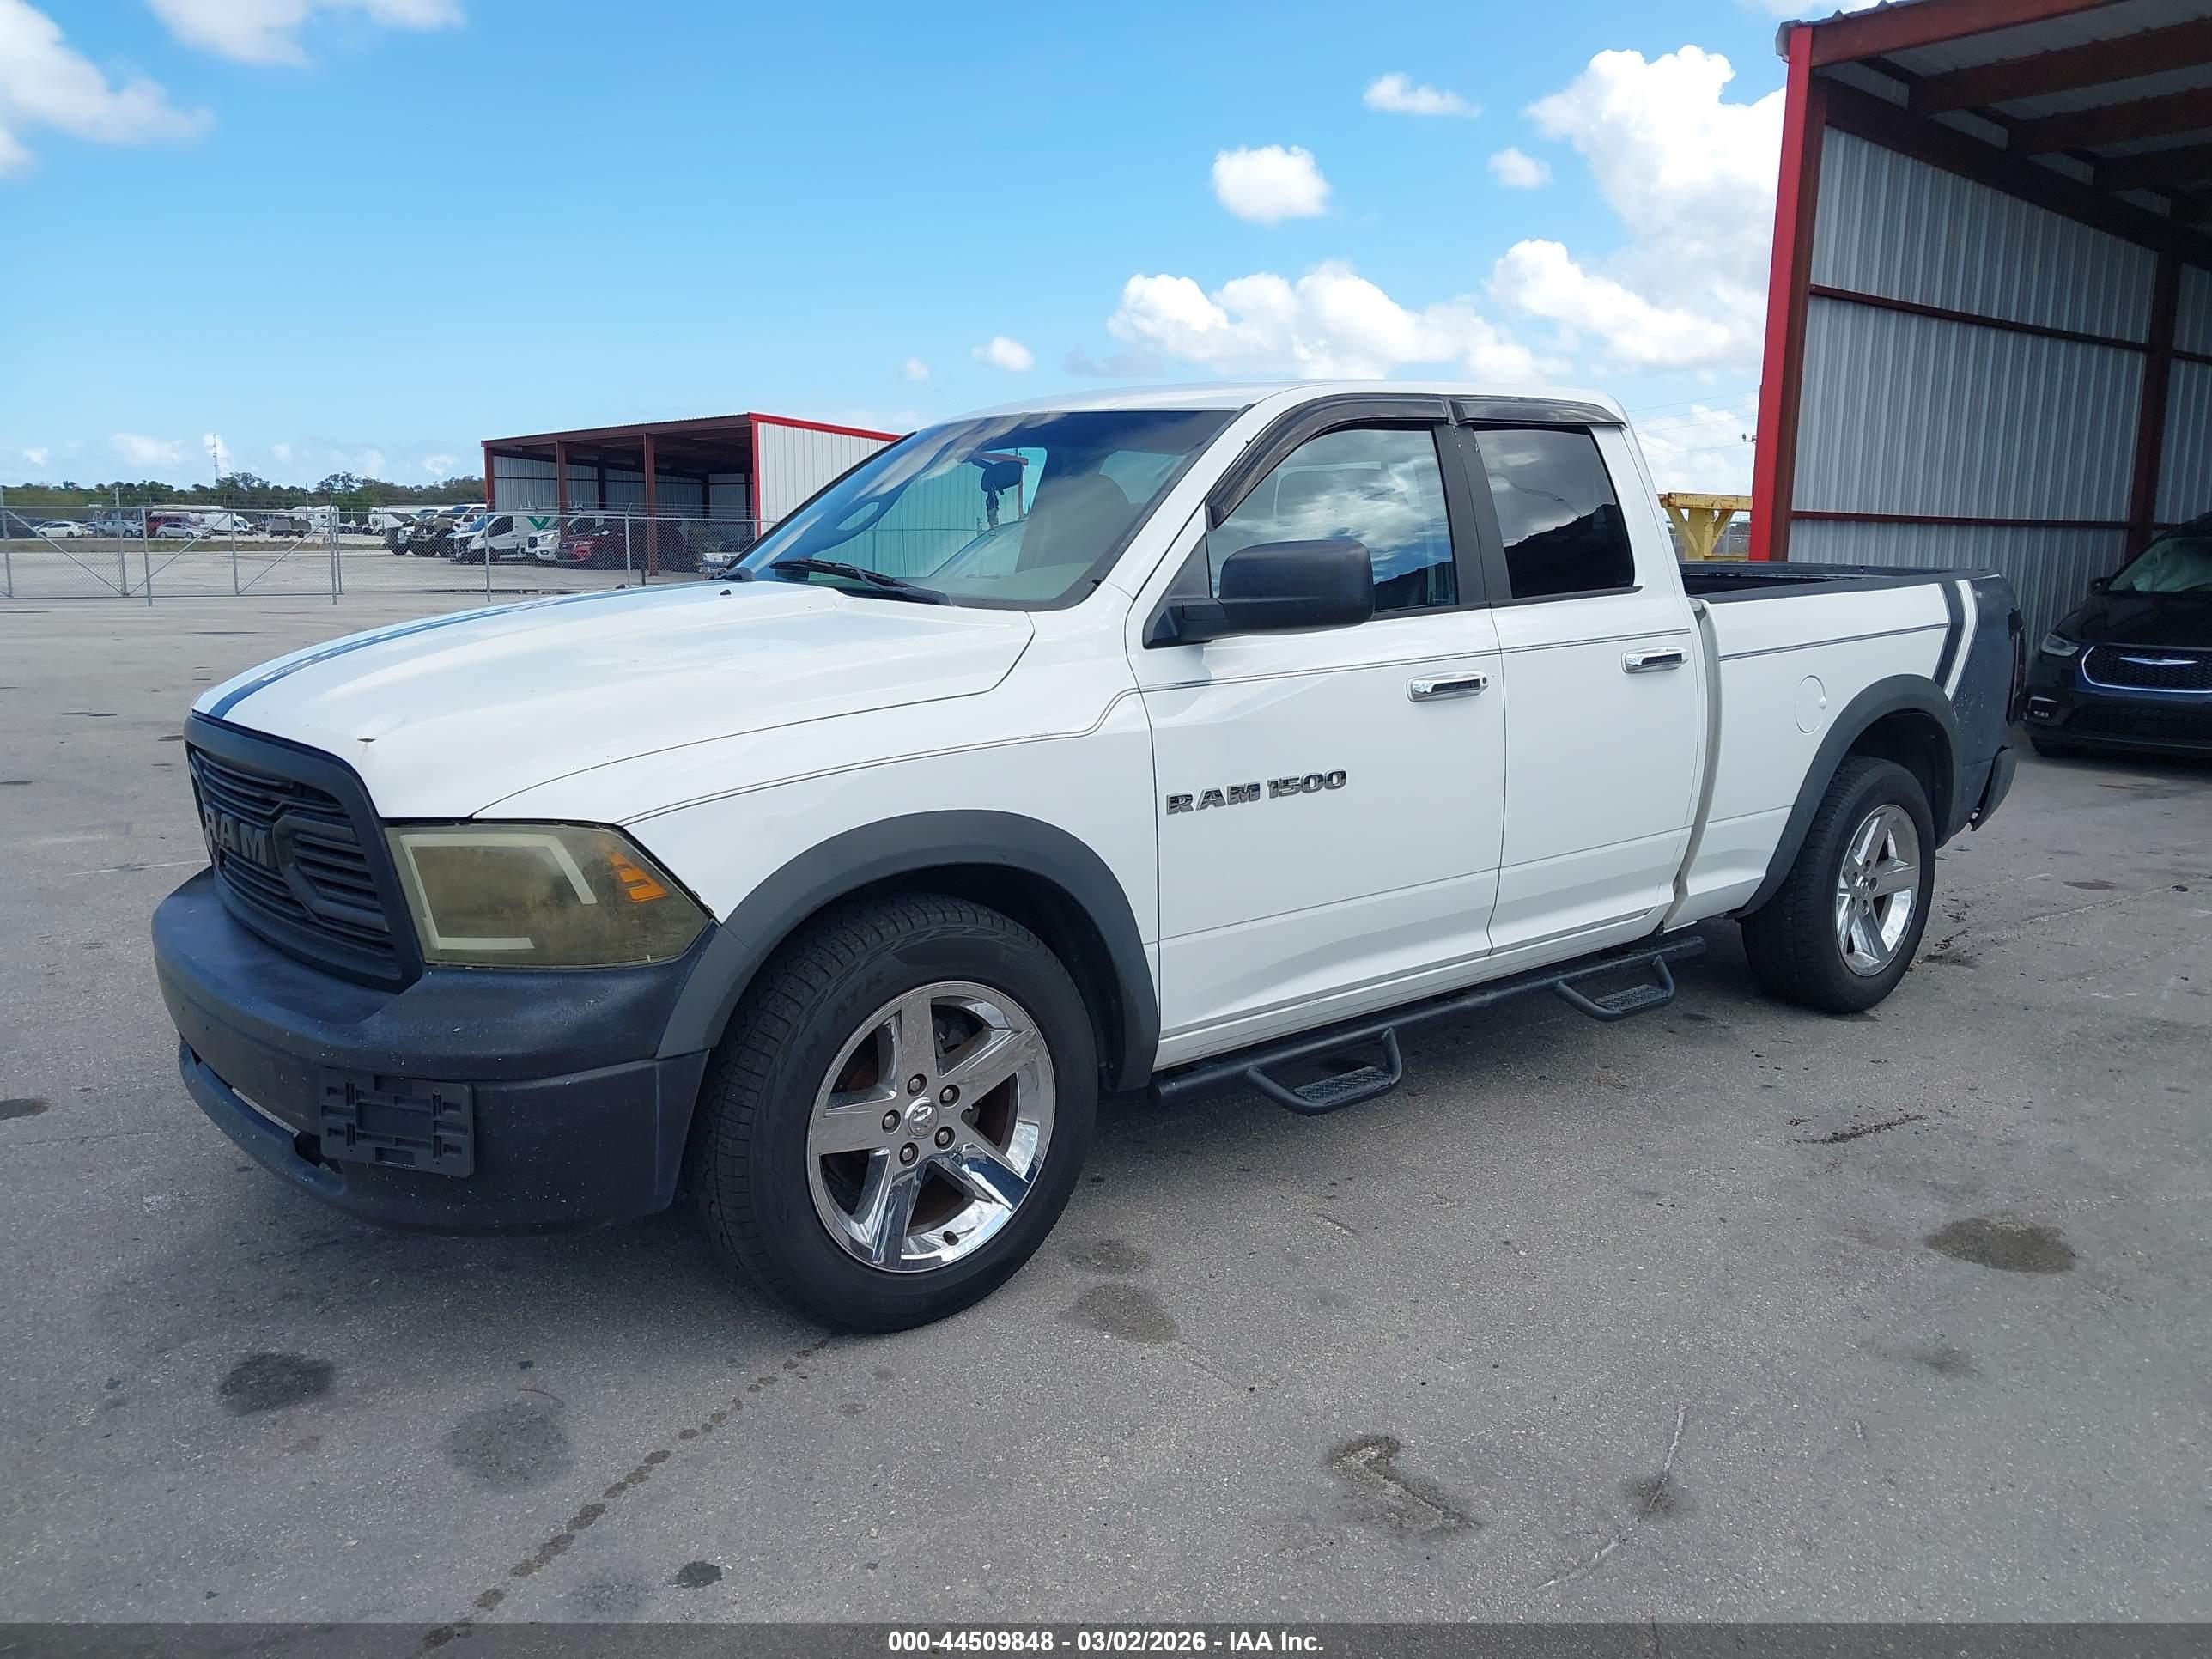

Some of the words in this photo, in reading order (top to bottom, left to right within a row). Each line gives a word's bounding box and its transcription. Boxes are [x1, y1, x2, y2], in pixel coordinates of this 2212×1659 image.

[1166, 782, 1261, 815] RAM
[1267, 769, 1347, 799] 1500
[204, 804, 270, 866] RAM
